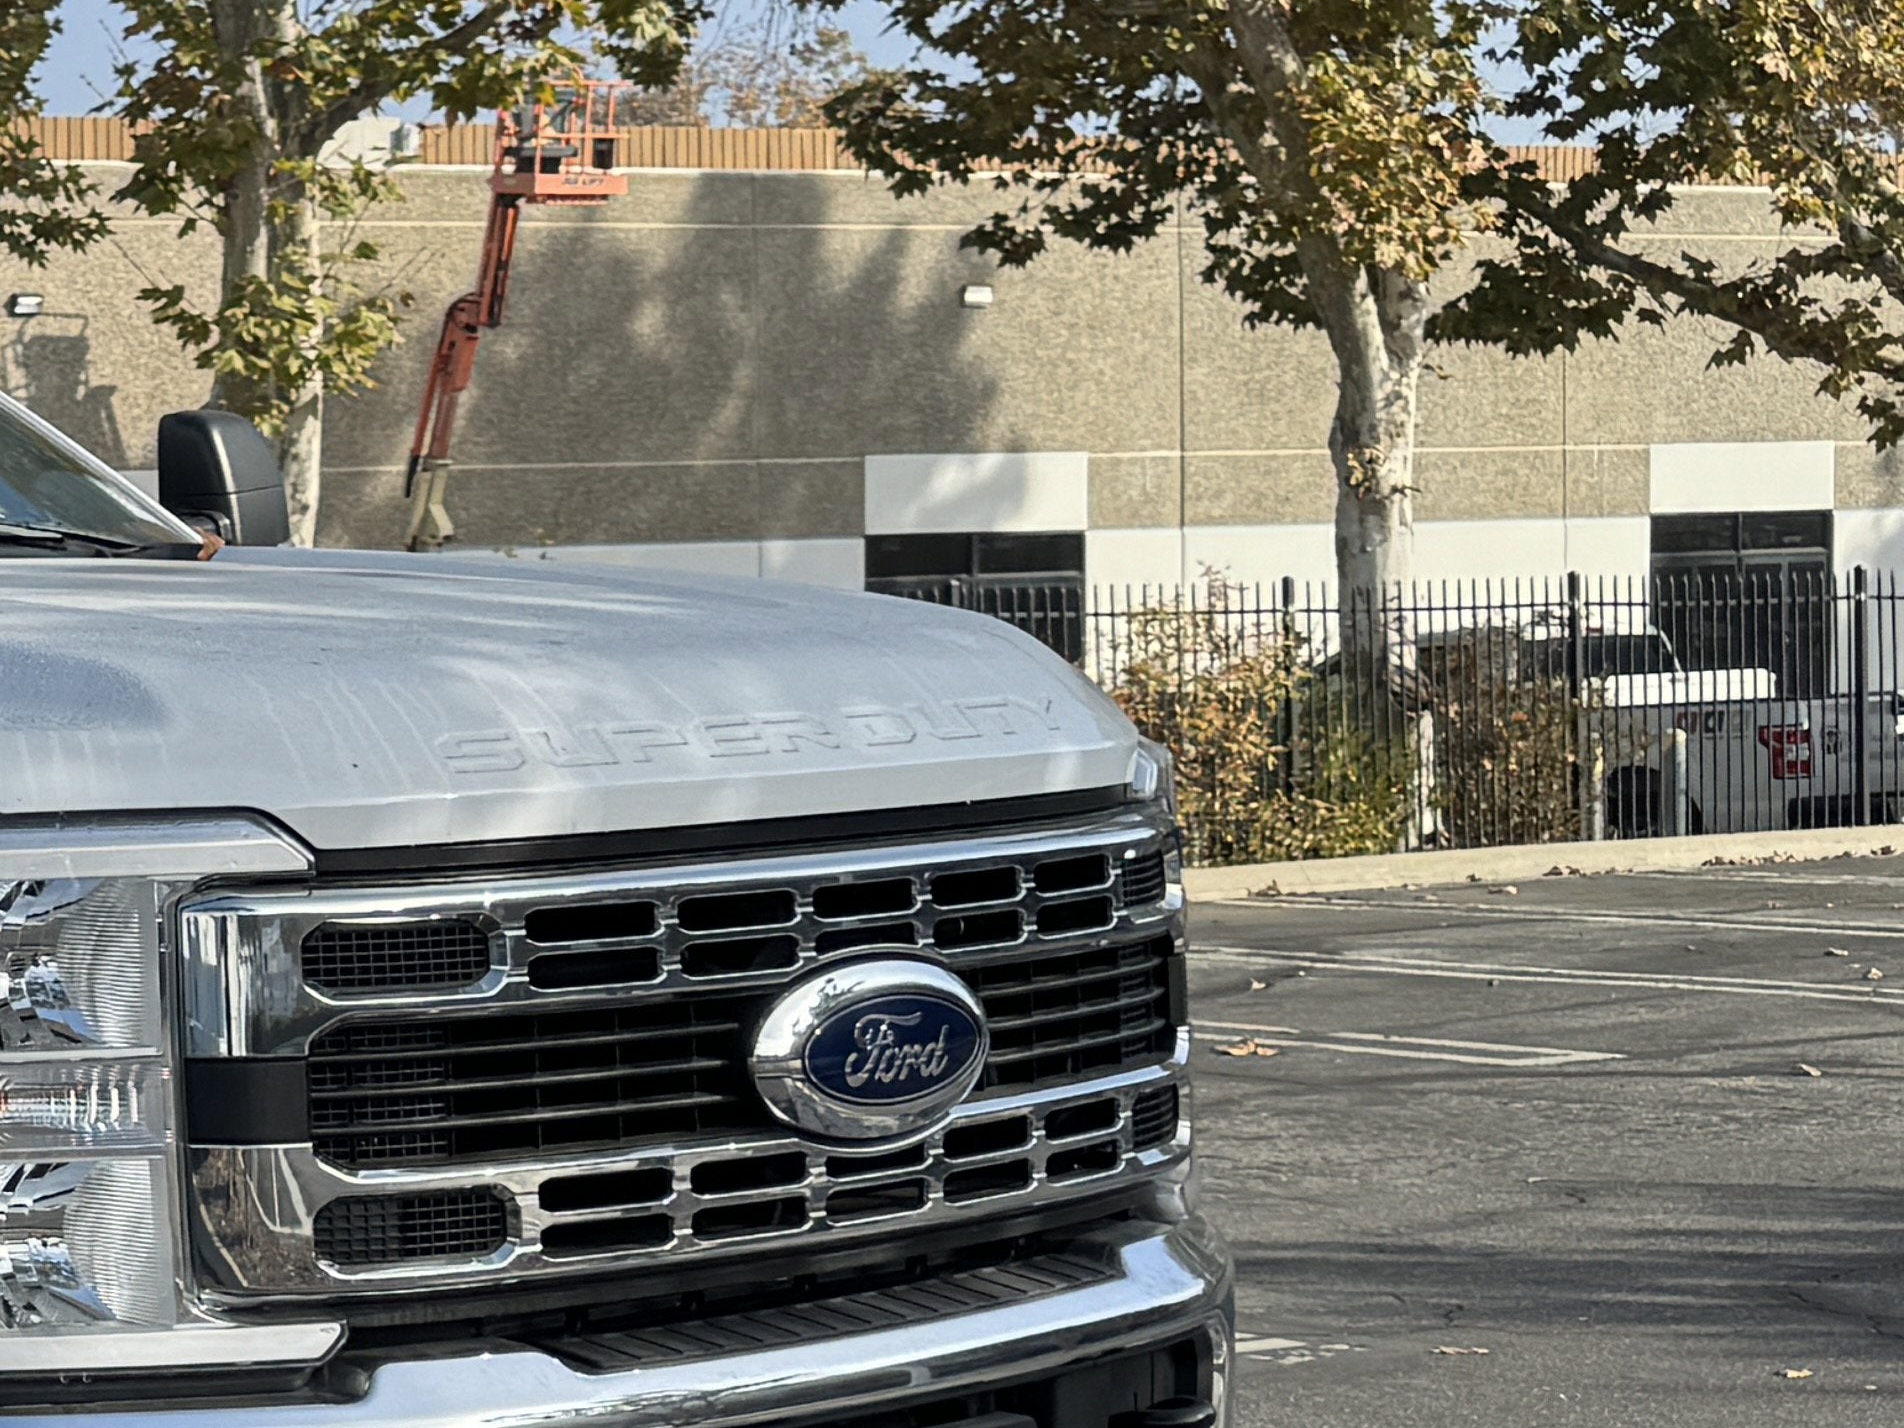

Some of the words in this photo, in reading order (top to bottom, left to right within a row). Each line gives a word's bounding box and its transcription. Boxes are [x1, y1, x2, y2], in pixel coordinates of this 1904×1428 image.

[437, 710, 841, 774] SUPER
[843, 695, 1062, 747] DUTY
[844, 1011, 950, 1088] Ford
